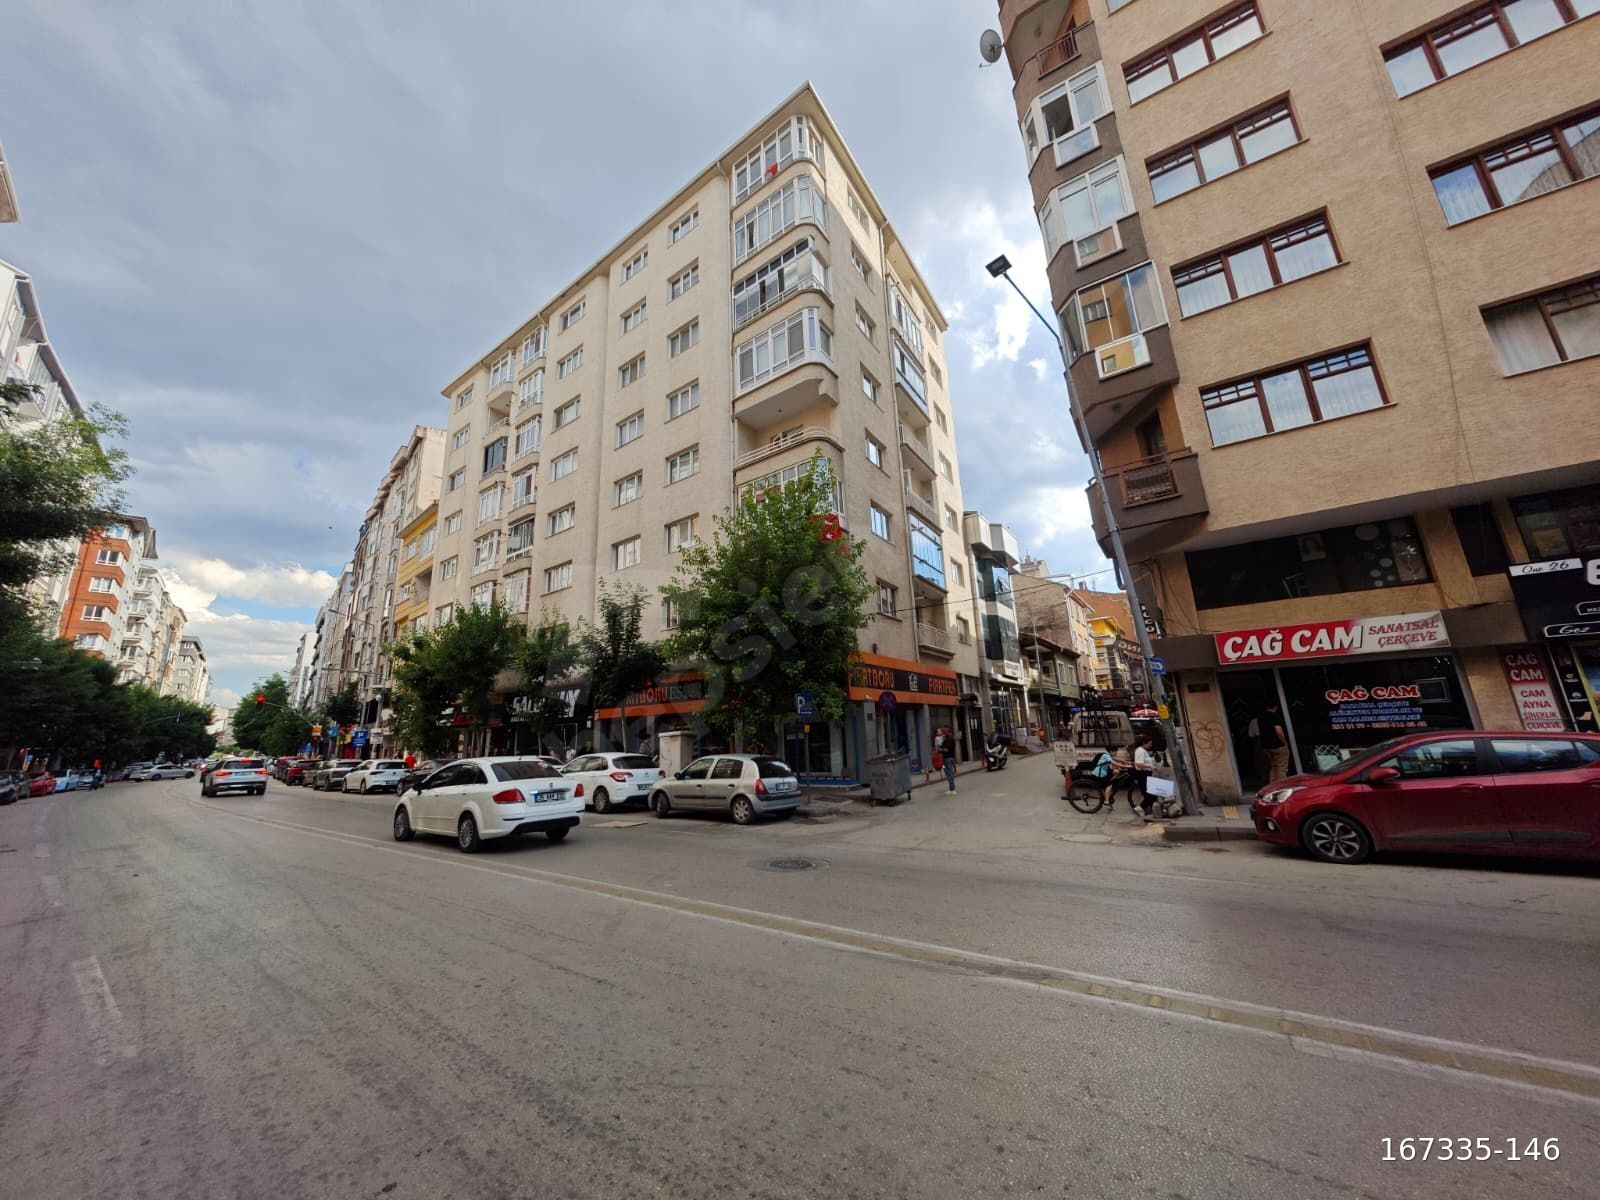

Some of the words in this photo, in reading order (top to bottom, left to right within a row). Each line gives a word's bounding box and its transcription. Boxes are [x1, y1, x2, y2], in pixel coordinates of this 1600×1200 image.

[1369, 620, 1438, 635] SANATSAL
[1223, 629, 1283, 661] ÇAĞ
[1291, 625, 1363, 653] CAM
[1378, 631, 1437, 647] ÇERÇEVE
[1510, 668, 1544, 681] CAM
[1325, 685, 1369, 704] ÇAĞ
[1371, 685, 1420, 699] CAM
[797, 696, 806, 714] P
[1523, 700, 1552, 709] AYNA
